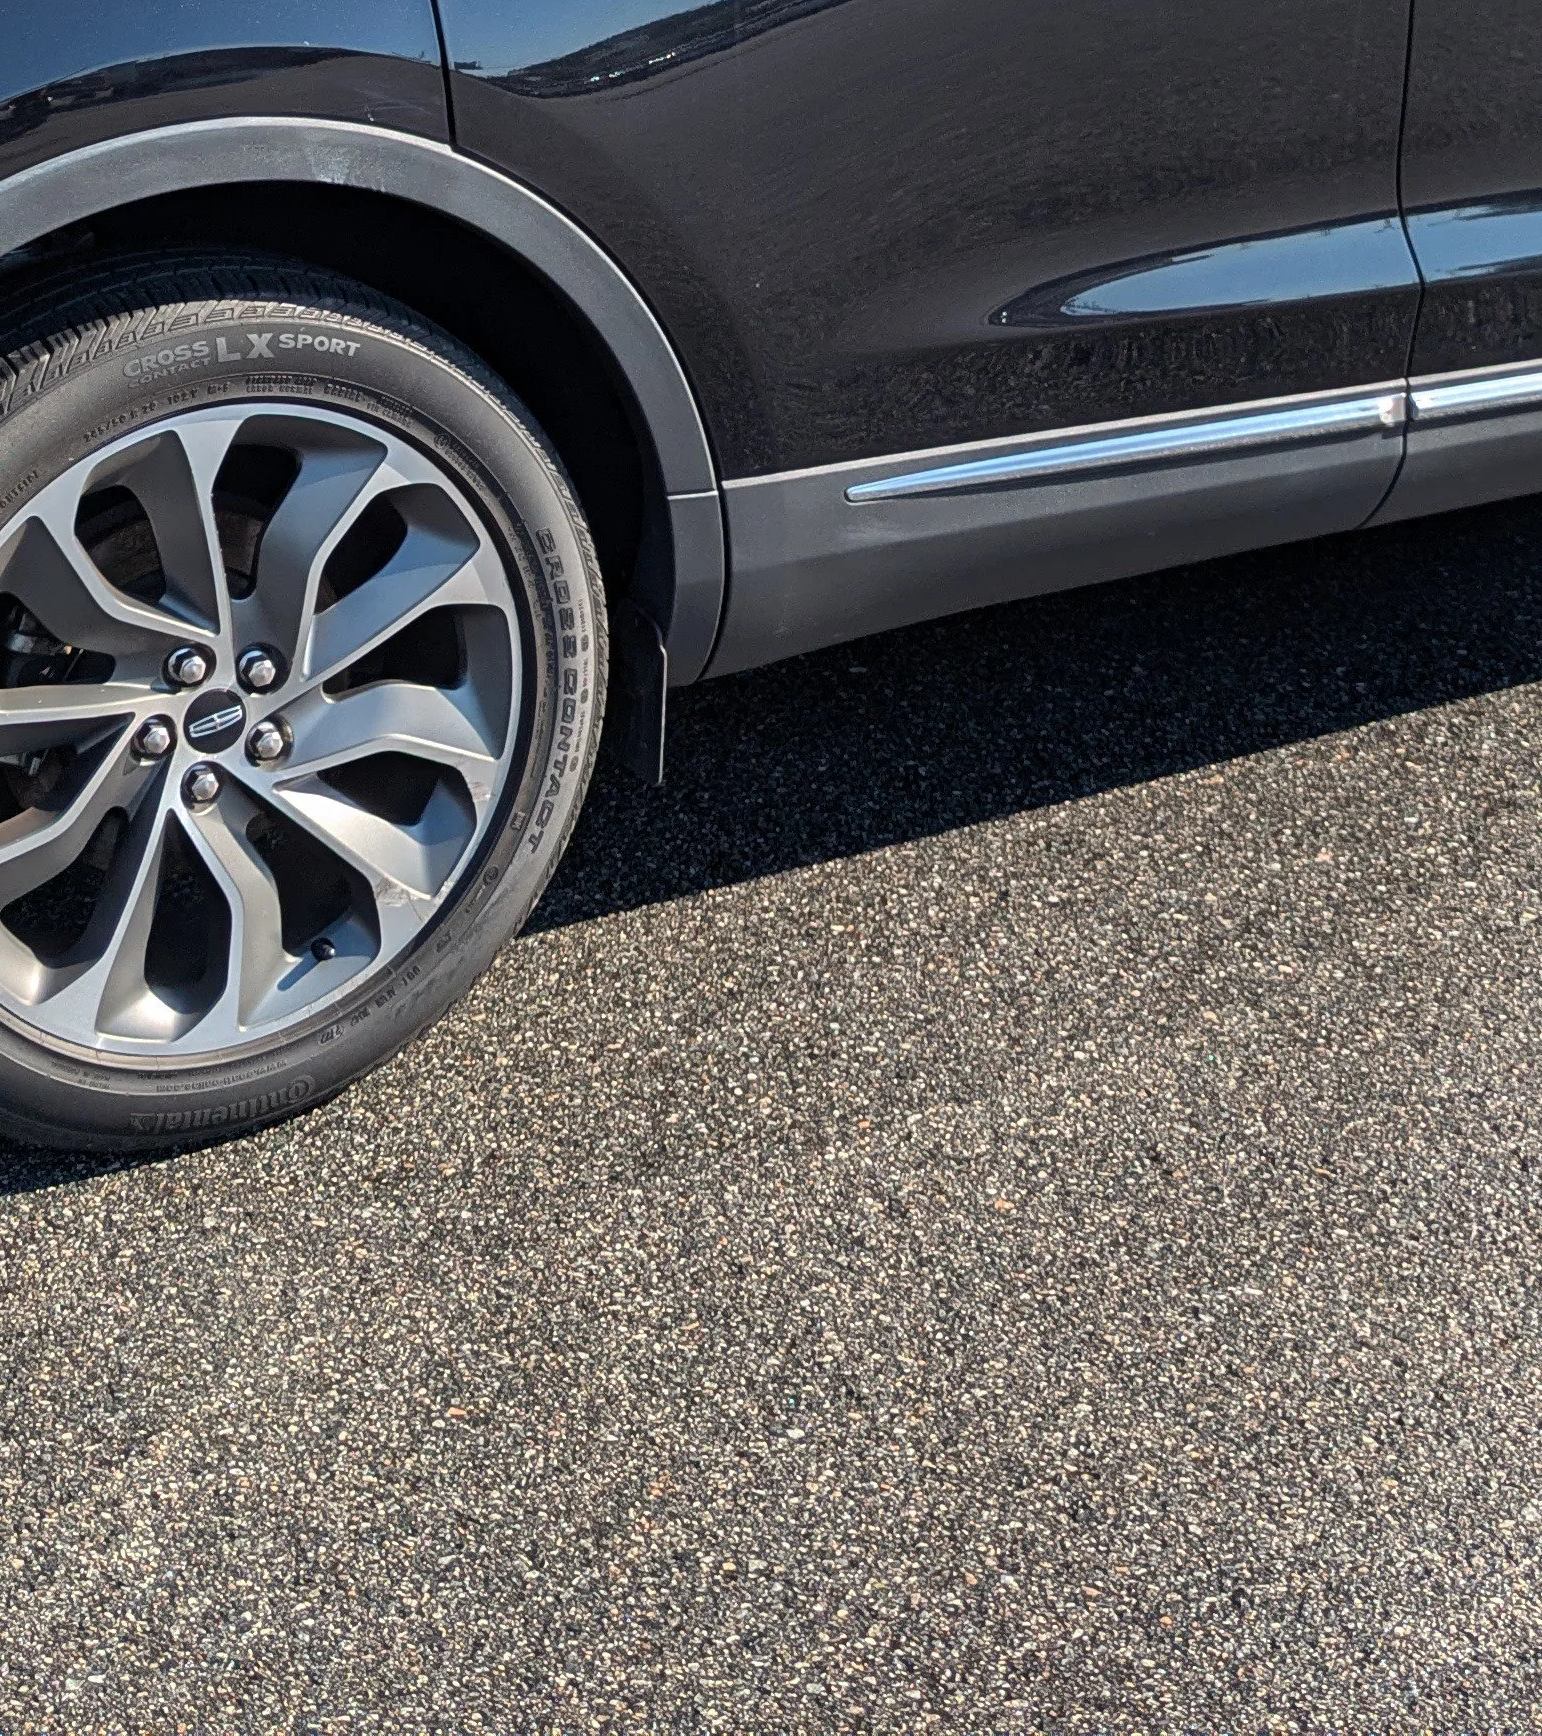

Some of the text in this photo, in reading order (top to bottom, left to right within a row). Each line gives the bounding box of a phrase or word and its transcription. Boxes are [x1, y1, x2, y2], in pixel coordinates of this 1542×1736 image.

[122, 339, 208, 378] CROSS
[278, 332, 361, 358] SPORT
[126, 357, 210, 389] CONTACT
[527, 667, 578, 855] CONTACT
[156, 1074, 316, 1133] Continental
